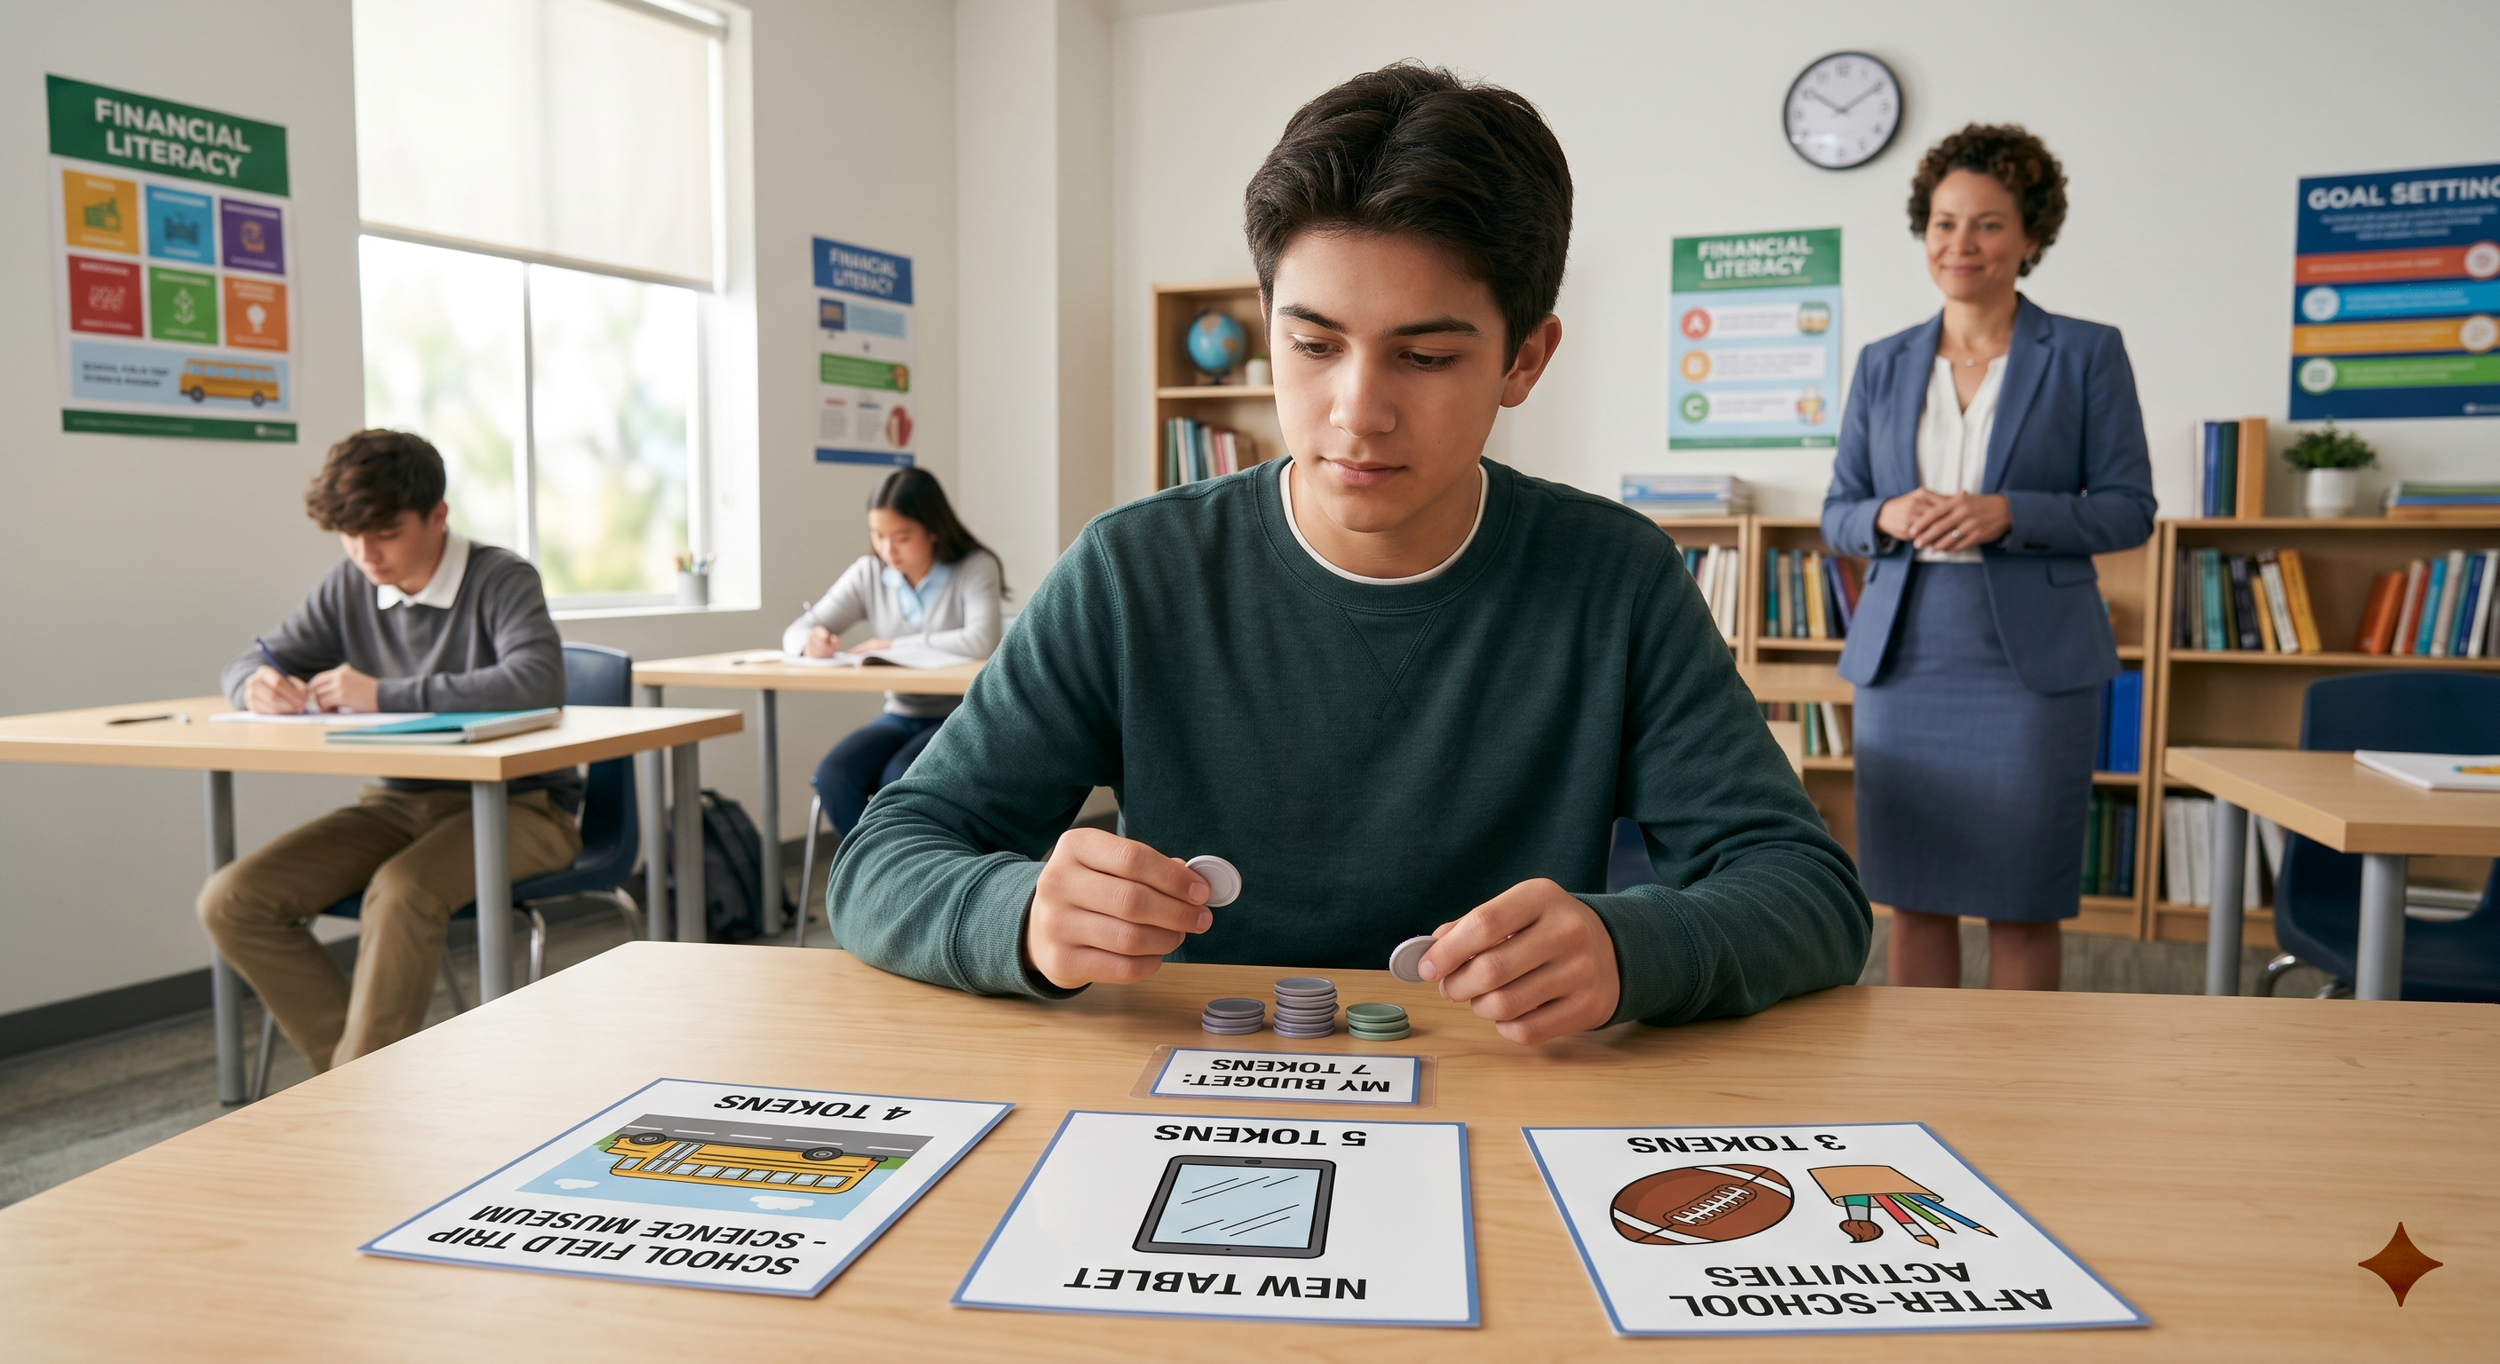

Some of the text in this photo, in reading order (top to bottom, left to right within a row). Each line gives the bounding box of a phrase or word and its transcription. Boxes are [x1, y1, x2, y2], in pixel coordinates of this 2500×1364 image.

[95, 96, 252, 153] FINANCIAL
[106, 129, 242, 179] LITERACY
[2307, 183, 2387, 211] GOAL
[1697, 236, 1814, 261] FINANCIAL
[828, 247, 898, 279] FINANCIAL
[1703, 256, 1807, 280] LITERACY
[832, 268, 895, 295] LITERACY
[1687, 313, 1706, 334] A
[1684, 396, 1704, 418] C
[1210, 1059, 1372, 1075] 7 TOKENS
[1182, 1074, 1391, 1093] MY BUDGET:
[713, 1094, 912, 1121] 4 TOKENS
[1153, 1124, 1367, 1147] 5 TOKENS
[1626, 1134, 1847, 1154] 3 TOKENS
[468, 1205, 641, 1235] MUSEUM
[639, 1221, 806, 1250] SCIENCE
[427, 1227, 800, 1276] SCHOOL FIELD TRIP
[1063, 1267, 1367, 1300] NEW TABLET
[1704, 1262, 1971, 1287] ACTIVITIES
[1668, 1288, 2053, 1317] AFTER-SCHOOL
